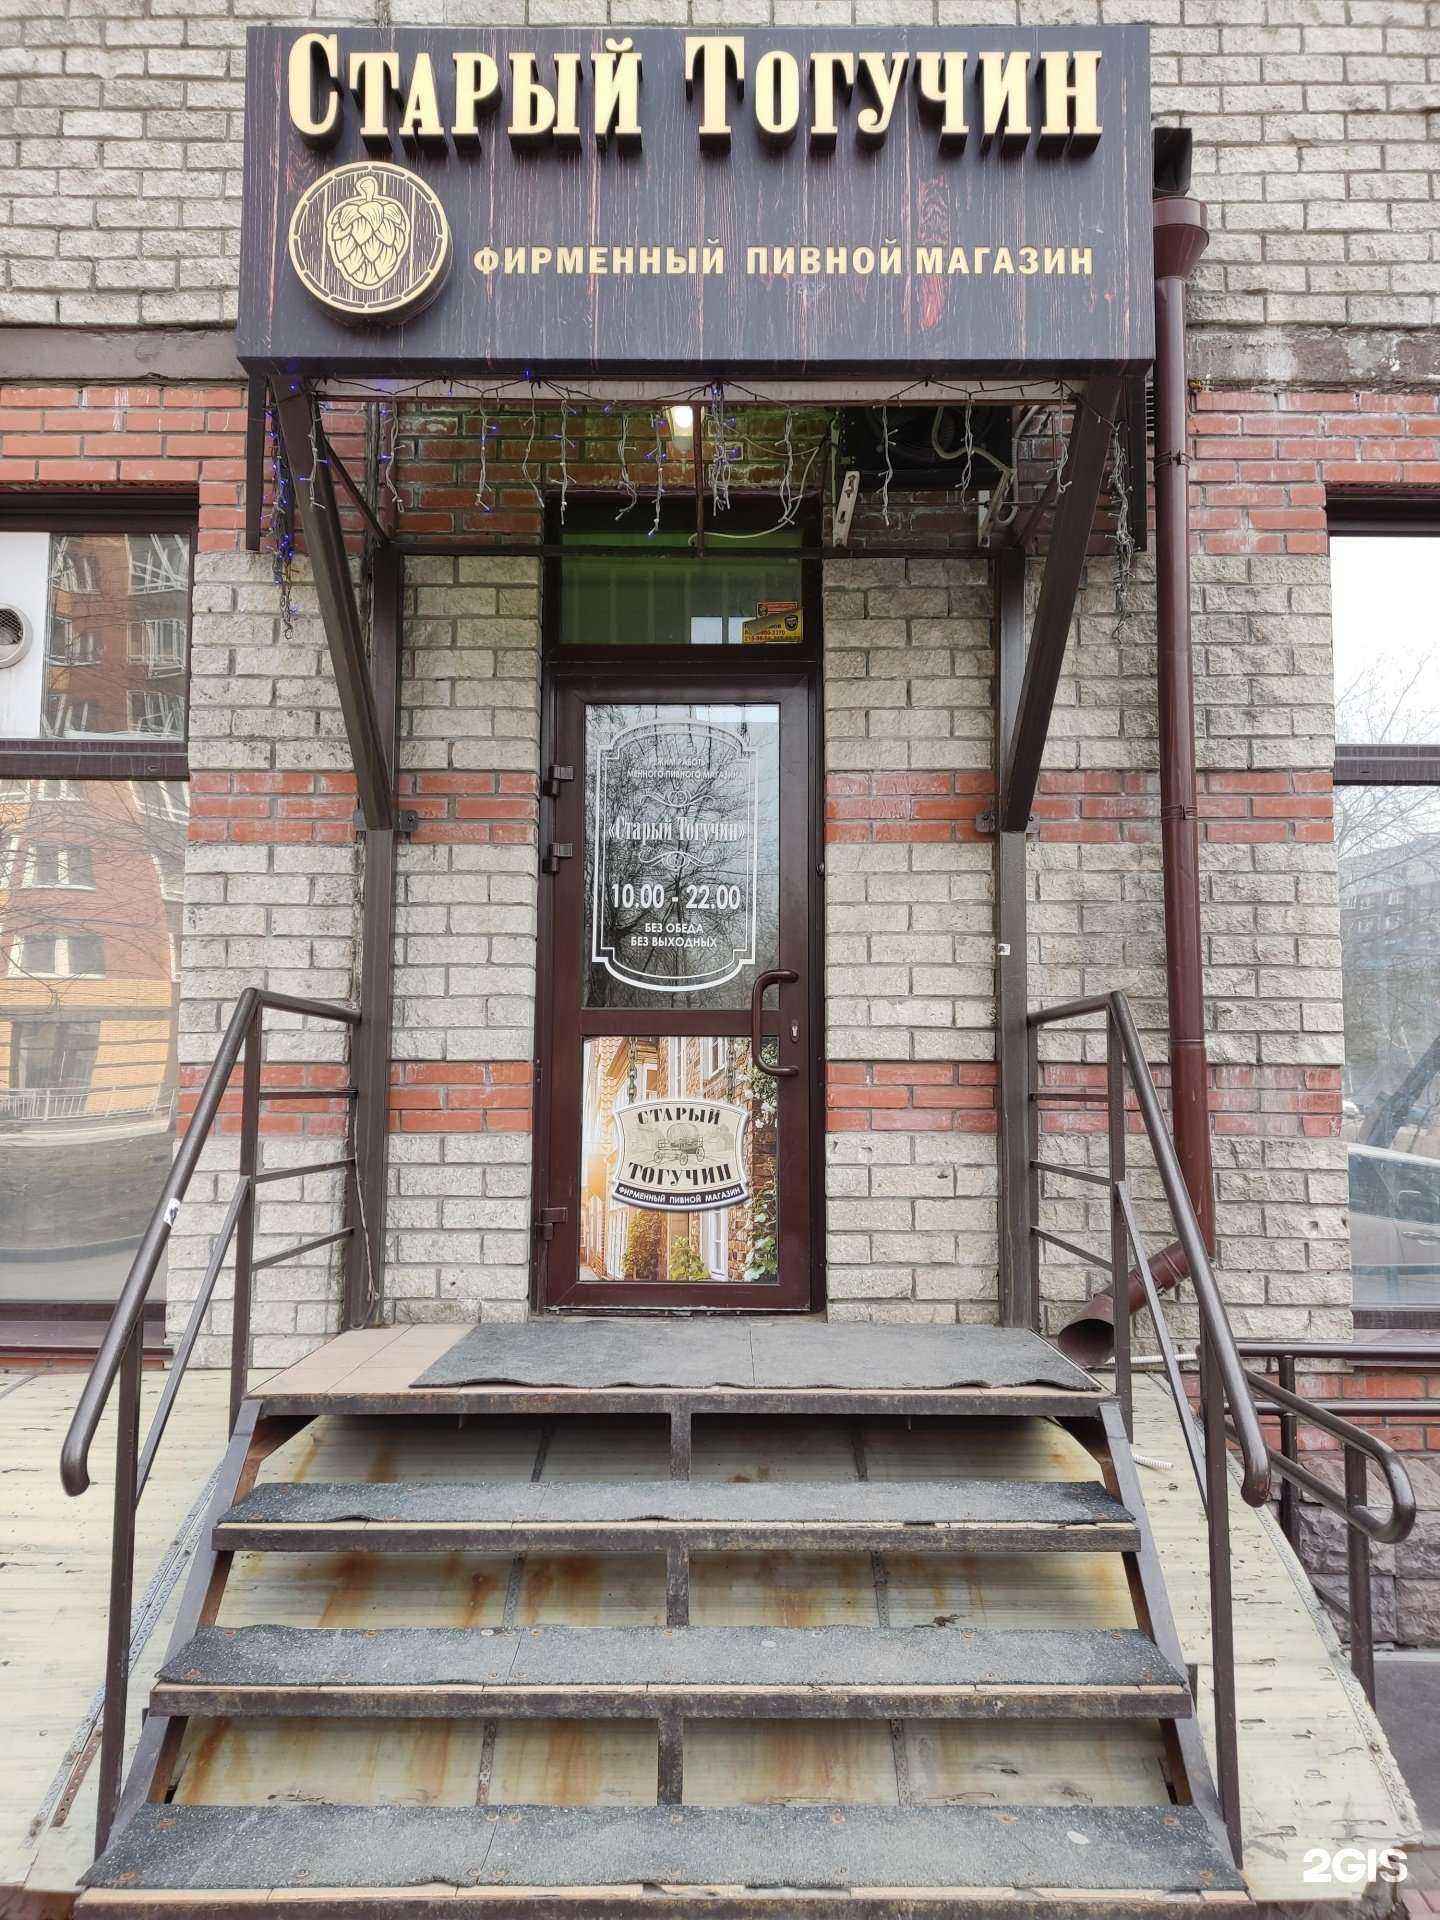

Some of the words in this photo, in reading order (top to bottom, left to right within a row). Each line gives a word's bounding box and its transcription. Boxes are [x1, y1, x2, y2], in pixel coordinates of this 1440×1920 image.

[473, 237, 726, 275] ФИРМЕННЫЙ
[747, 238, 903, 275] ПИВНОЙ
[915, 247, 1094, 275] МАГАЗИН
[685, 884, 741, 909] 22.00
[645, 923, 663, 933] БЕЗ
[665, 923, 704, 934] ОБЕДА
[630, 937, 649, 947] БЕЗ
[651, 936, 718, 948] ВЫХОДНЫХ
[637, 1107, 721, 1125] СТАРЫЙ
[628, 1162, 732, 1186] ТОГУЧИН
[618, 1187, 666, 1204] ФИРМЕННЫЙ
[669, 1194, 701, 1204] ПИВНОЙ
[705, 1188, 740, 1202] МАГАЗИН
